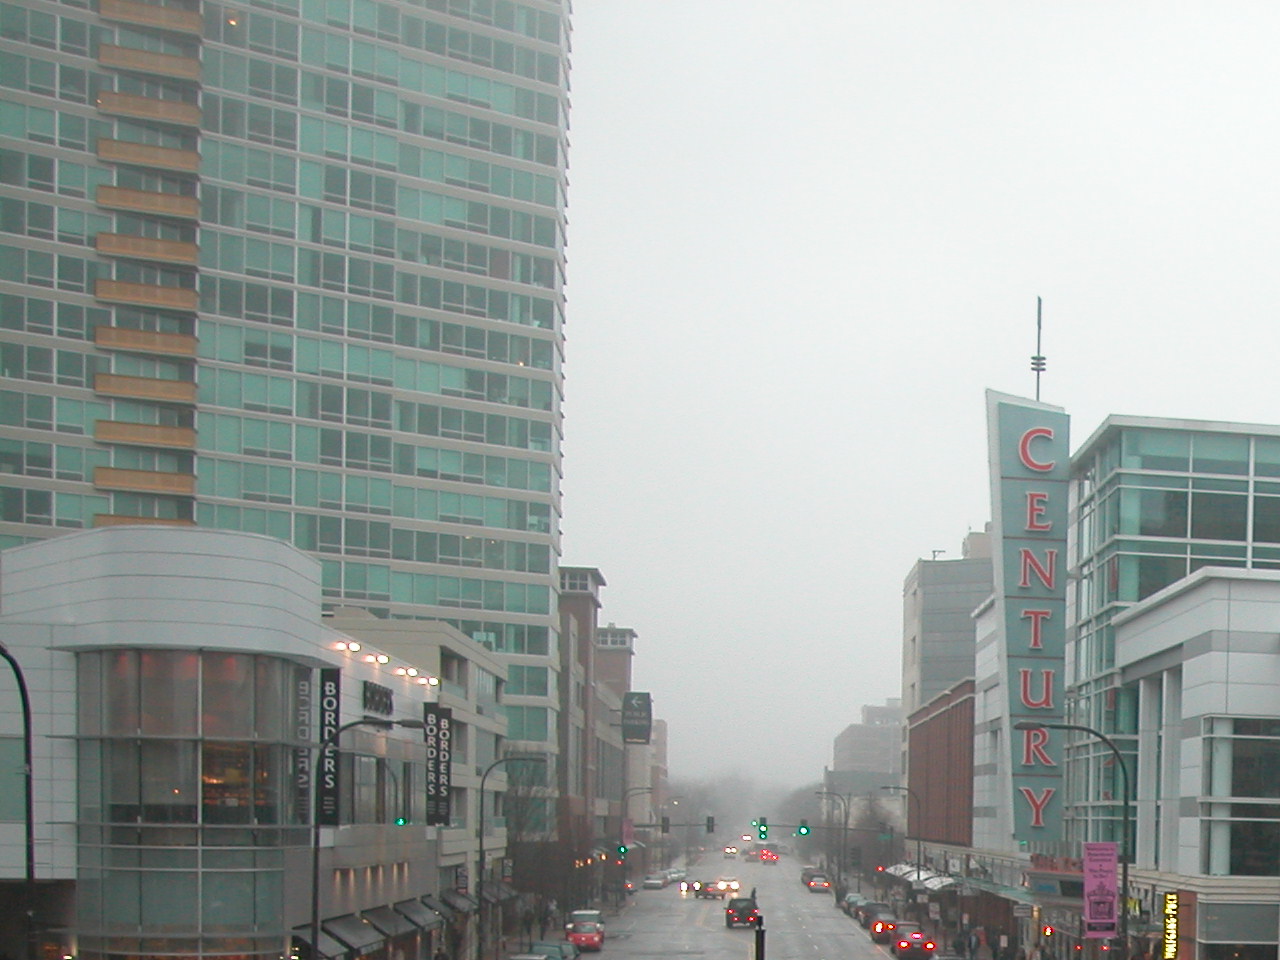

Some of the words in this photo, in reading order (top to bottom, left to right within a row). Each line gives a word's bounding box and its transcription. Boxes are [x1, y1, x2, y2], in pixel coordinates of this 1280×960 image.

[1017, 426, 1059, 828] CENTURY
[322, 681, 339, 789] BORDERS
[426, 713, 438, 796] BORDERS
[438, 718, 450, 797] BORDERS
